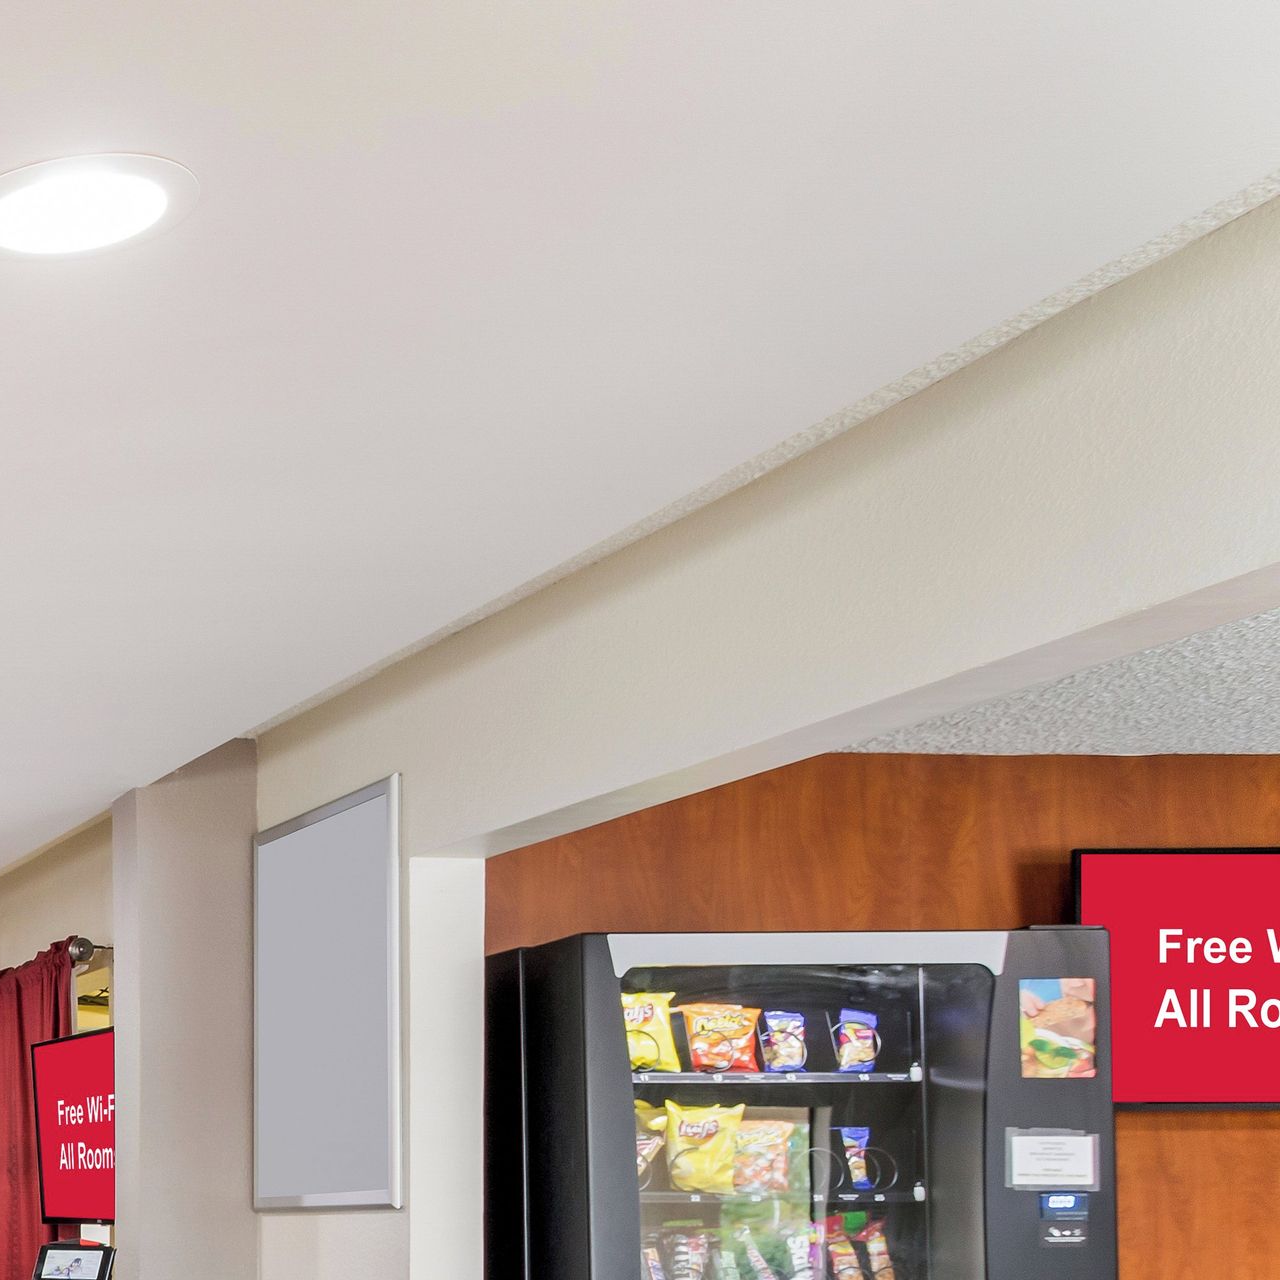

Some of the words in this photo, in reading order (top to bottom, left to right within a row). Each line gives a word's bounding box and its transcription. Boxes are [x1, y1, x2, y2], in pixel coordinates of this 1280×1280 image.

[1159, 928, 1253, 964] Free
[1154, 988, 1211, 1028] All
[57, 1099, 84, 1126] Free
[86, 1094, 115, 1123] Wi-F
[59, 1142, 75, 1170] All
[77, 1141, 115, 1170] Room
